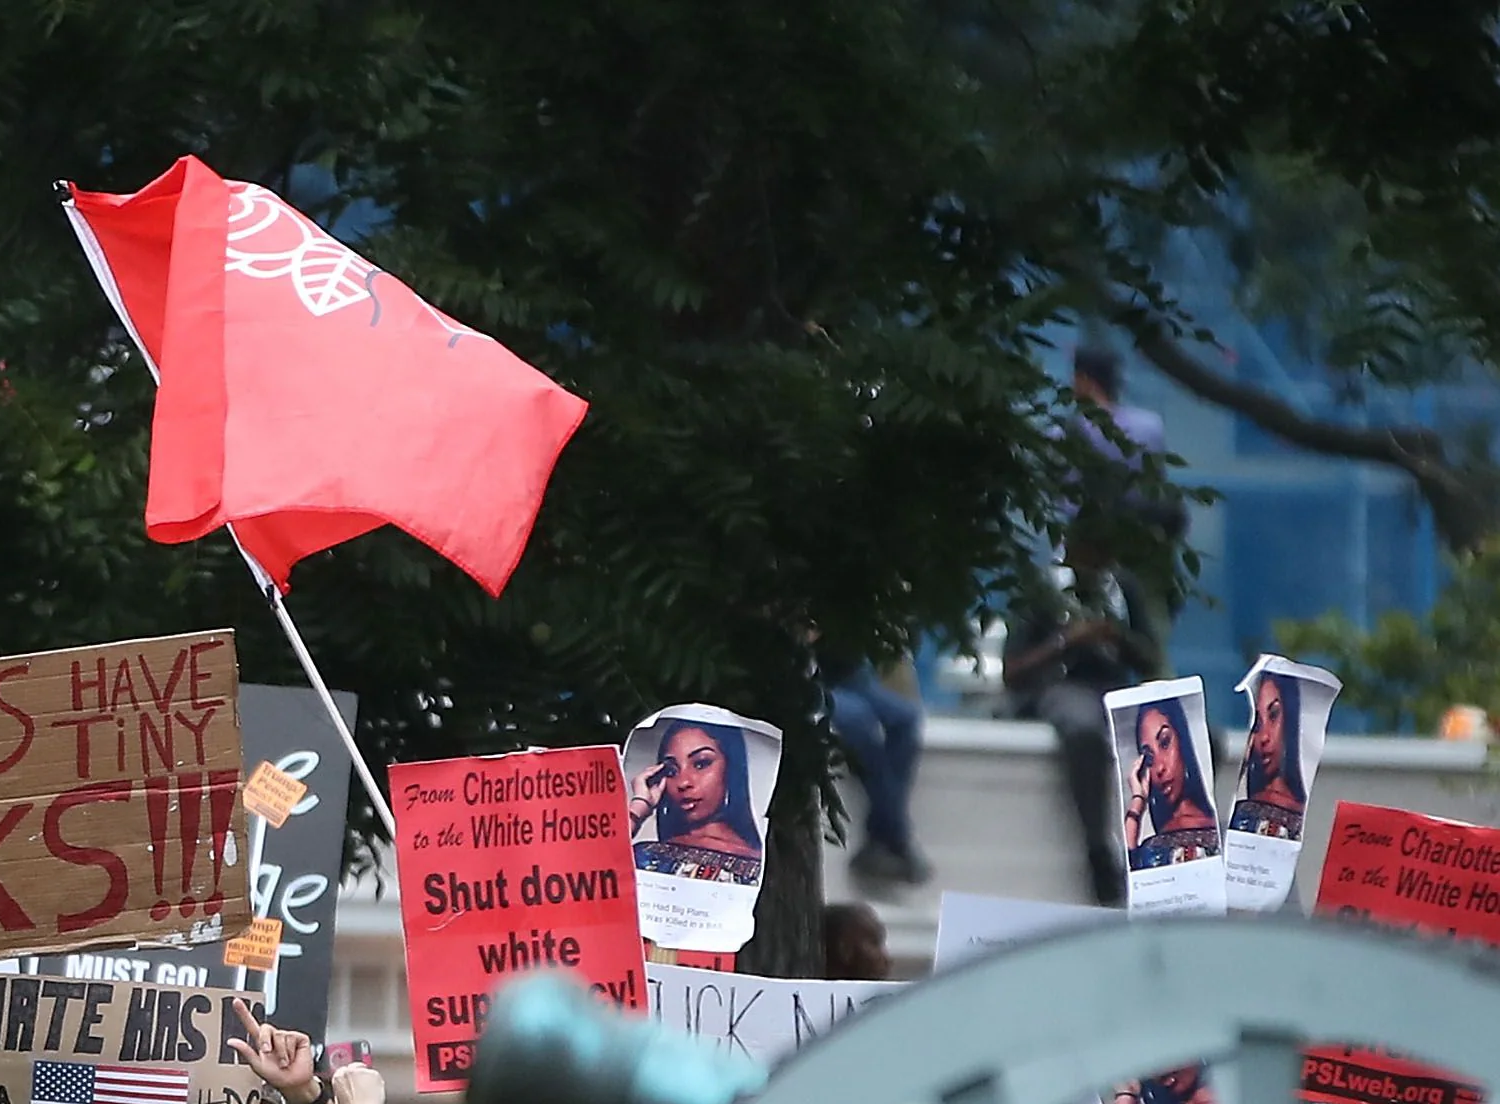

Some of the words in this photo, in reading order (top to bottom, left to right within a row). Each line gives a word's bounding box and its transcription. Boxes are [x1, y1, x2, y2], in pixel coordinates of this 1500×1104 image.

[70, 640, 225, 713] HAVE
[404, 783, 457, 811] From
[463, 760, 617, 806] Charlottesville
[413, 830, 430, 850] to
[437, 822, 465, 848] the
[470, 812, 534, 849] White
[541, 808, 617, 844] House:
[1341, 823, 1394, 847] From
[424, 868, 510, 916] Shut
[520, 864, 619, 907] down
[1337, 866, 1355, 882] to
[1361, 865, 1390, 889] the
[1395, 865, 1462, 908] White
[477, 928, 582, 975] white
[119, 987, 212, 1062] HAS
[426, 969, 638, 1033] supcy!
[648, 977, 765, 1060] UCK
[438, 1045, 476, 1072] PS
